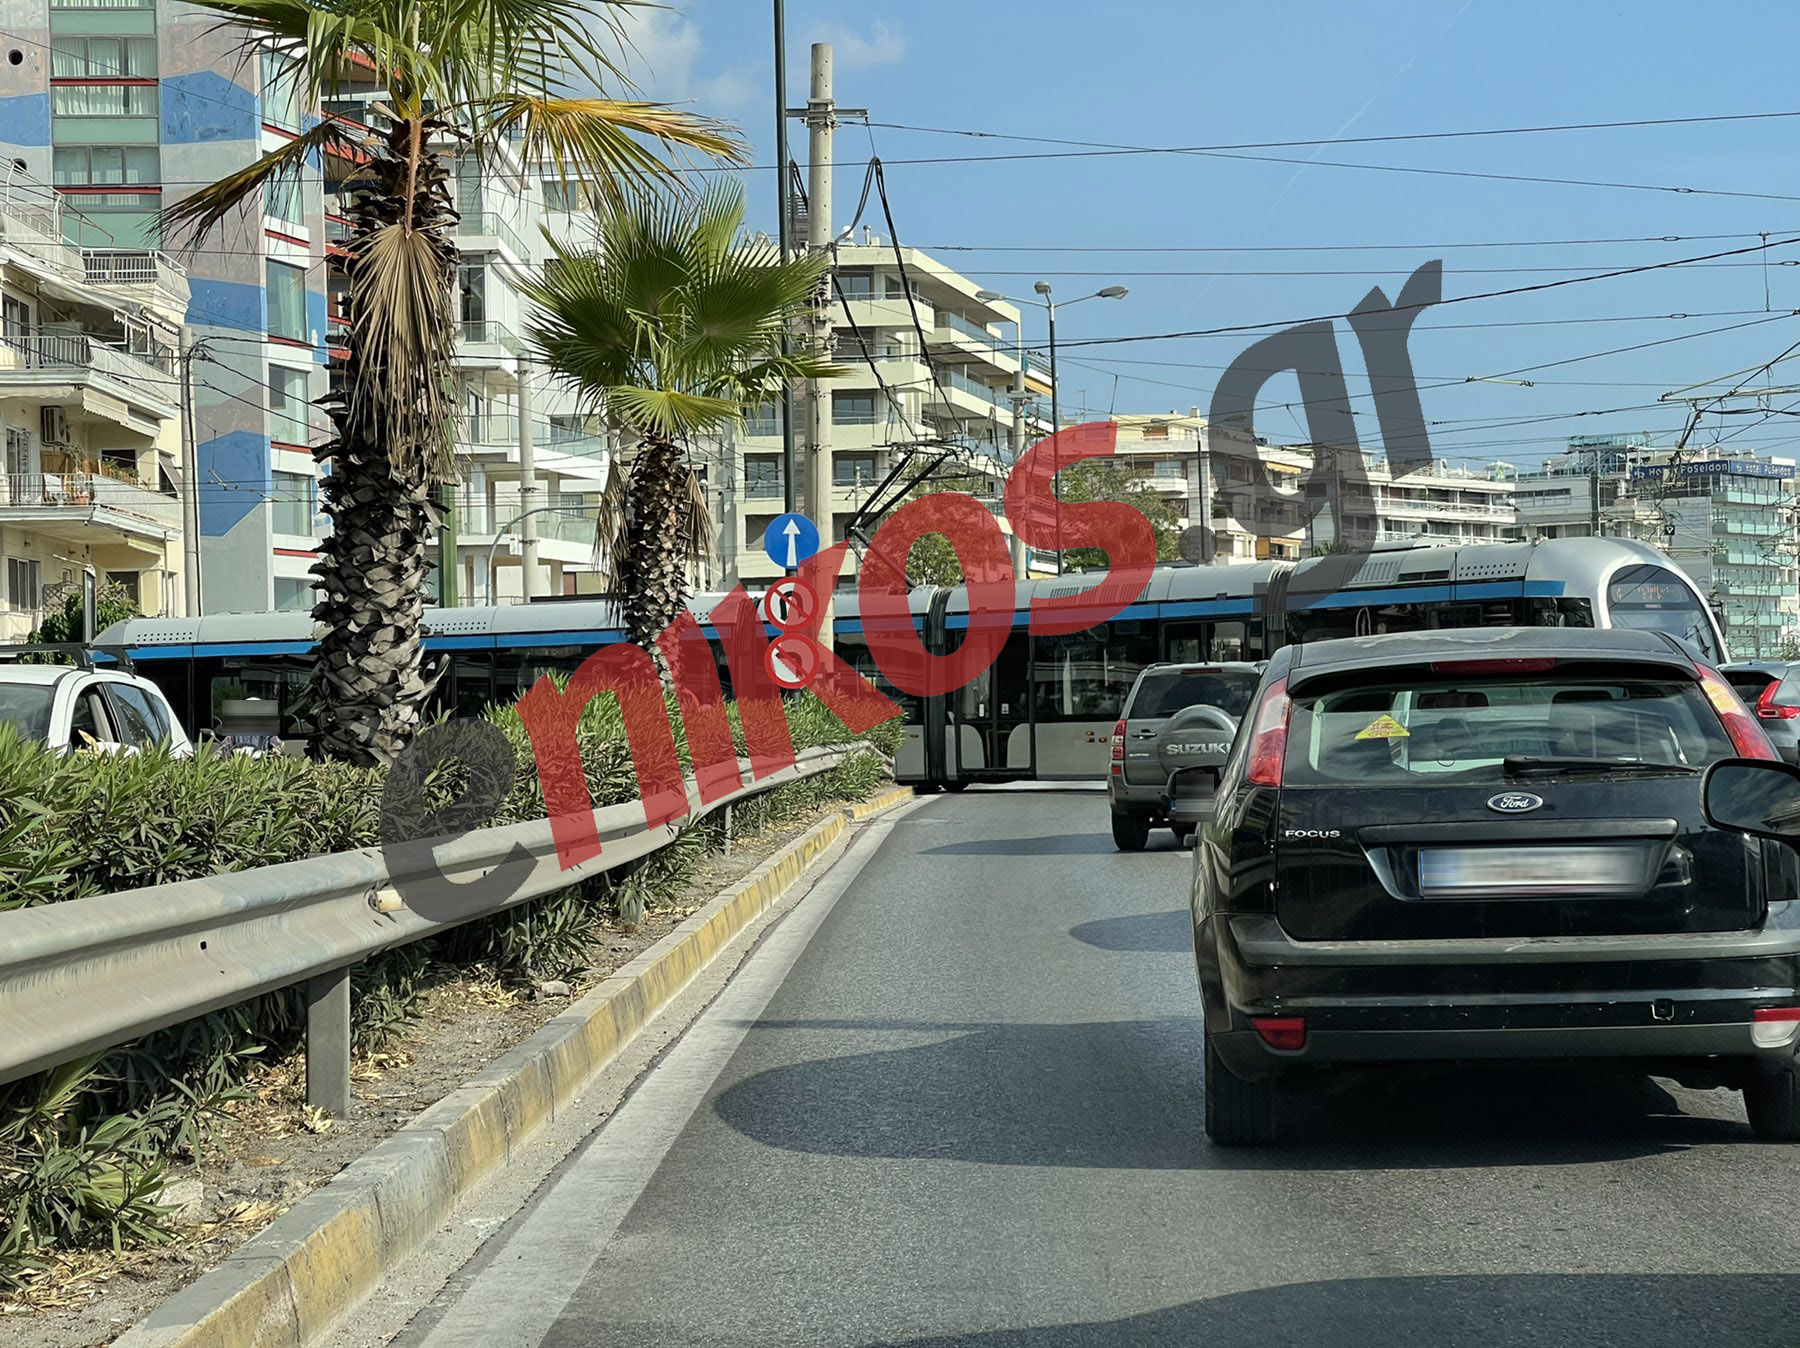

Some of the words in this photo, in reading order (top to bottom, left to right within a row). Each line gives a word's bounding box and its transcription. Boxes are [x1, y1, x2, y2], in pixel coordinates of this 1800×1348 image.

[1166, 743, 1231, 755] SUZUKI
[1500, 796, 1529, 808] Ford
[1285, 829, 1341, 838] FOCUS
